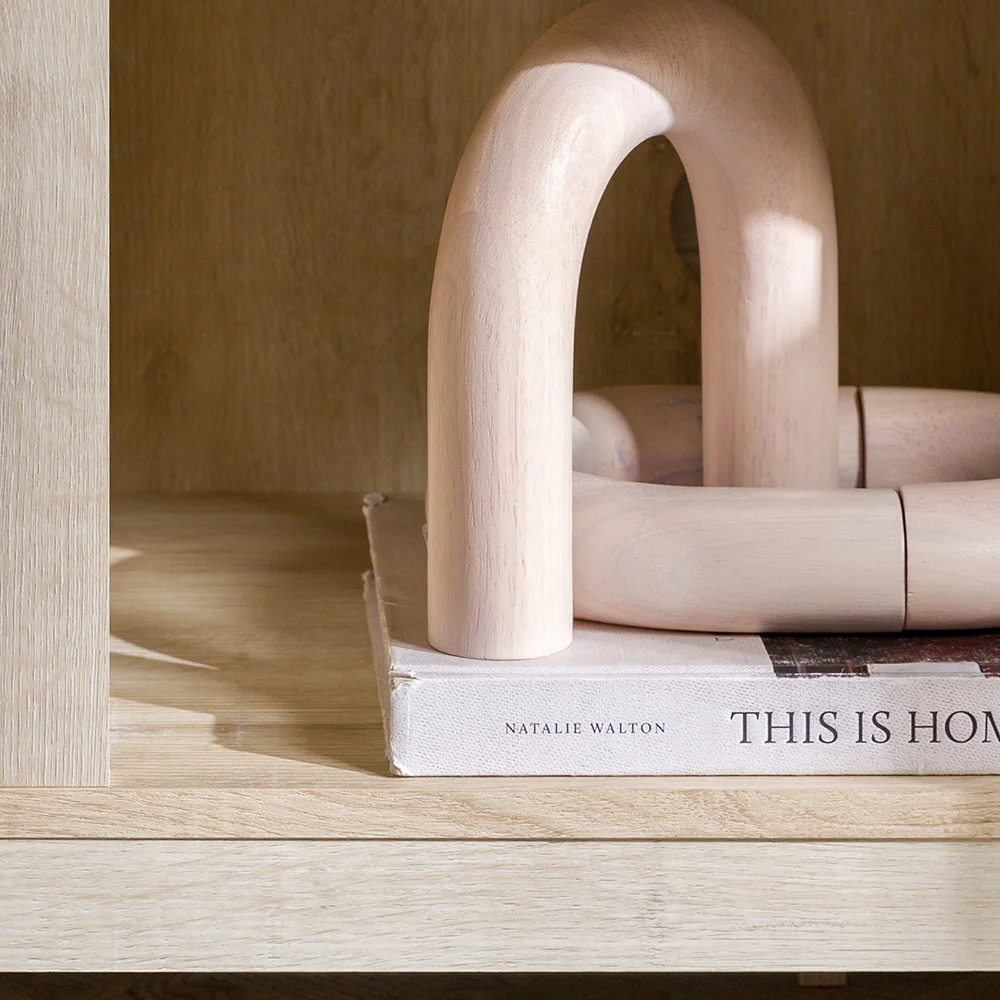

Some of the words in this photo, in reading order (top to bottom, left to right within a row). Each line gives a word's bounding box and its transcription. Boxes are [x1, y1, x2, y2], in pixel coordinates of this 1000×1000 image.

[505, 722, 583, 735] NATALIE
[588, 722, 667, 735] WALTON
[729, 710, 839, 745] THIS
[854, 710, 892, 744] IS
